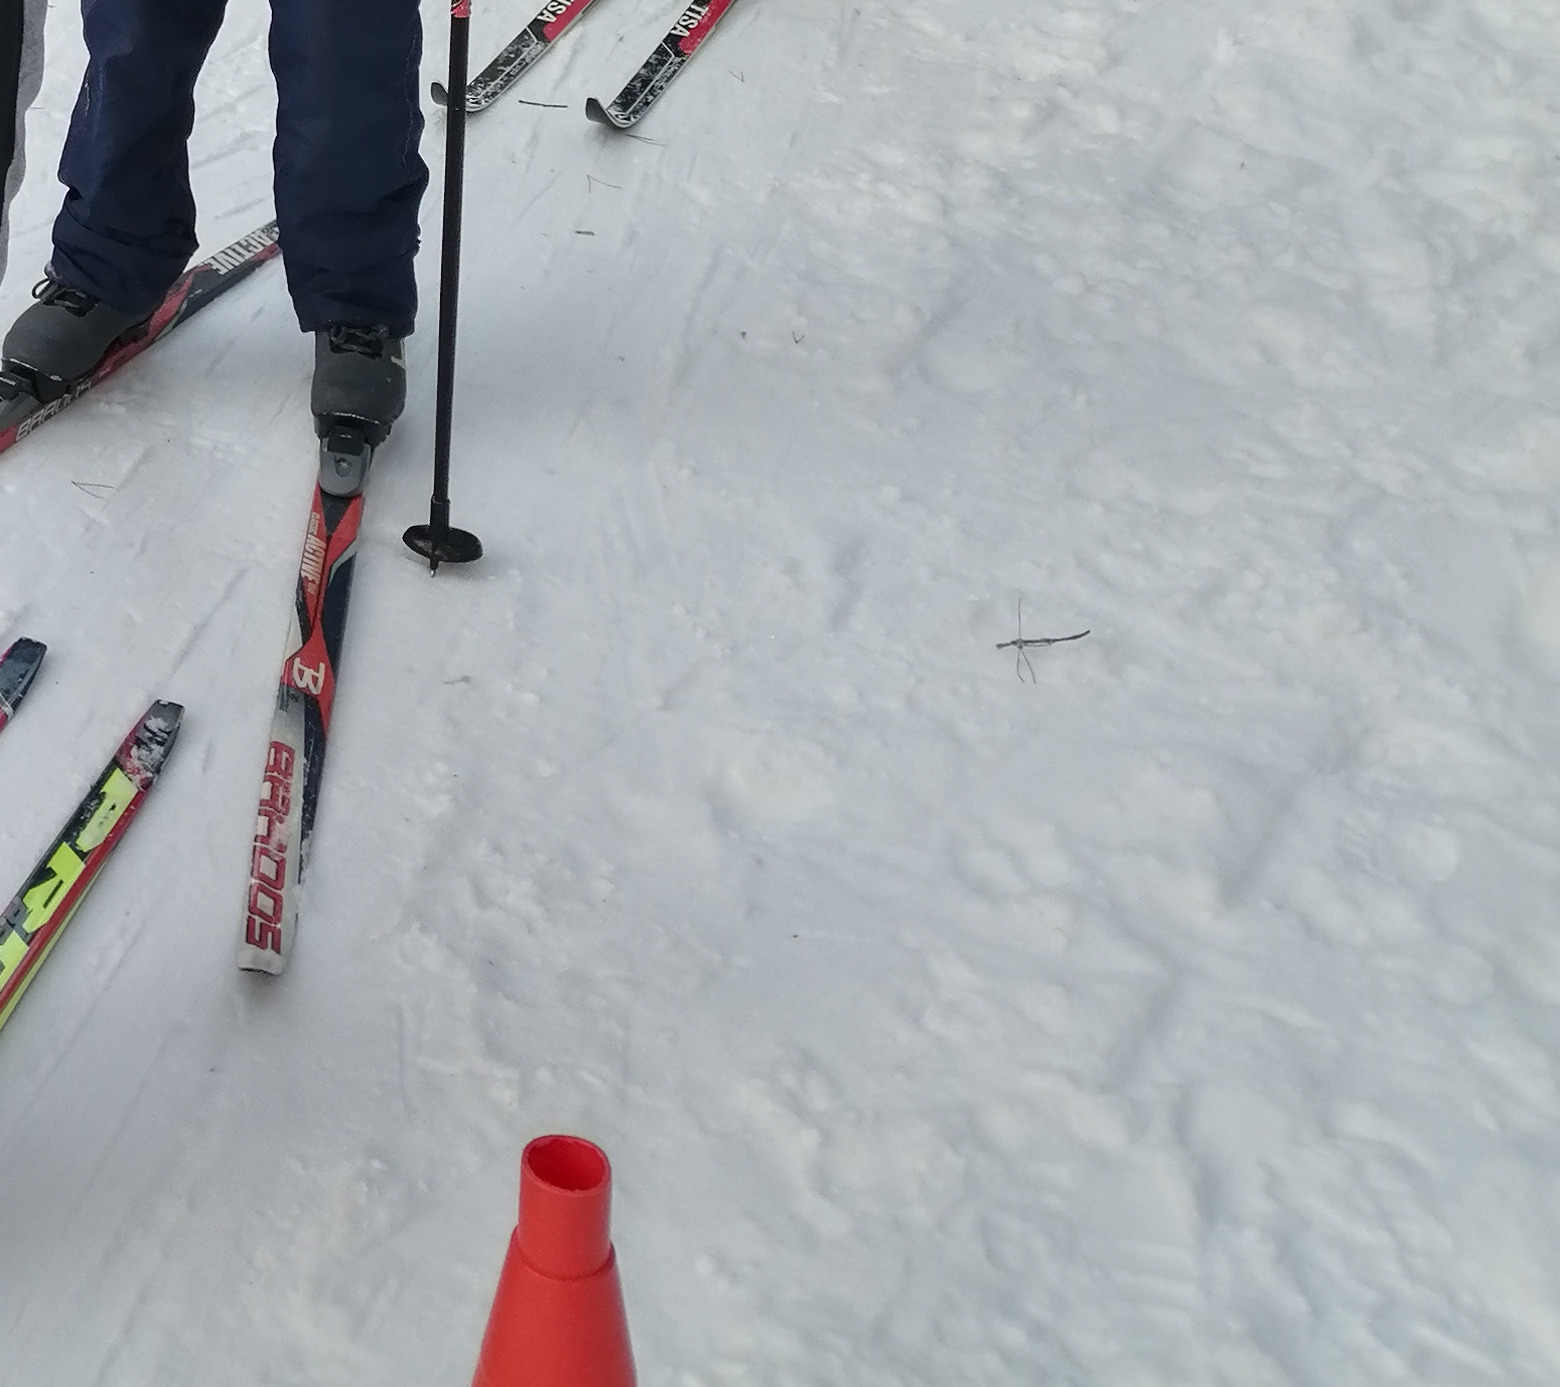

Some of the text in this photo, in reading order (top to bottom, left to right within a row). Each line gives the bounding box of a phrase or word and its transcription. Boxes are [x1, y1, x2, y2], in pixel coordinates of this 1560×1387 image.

[670, 4, 709, 38] TISA
[208, 227, 275, 276] ACTIVE
[300, 533, 326, 584] ACTIVE
[293, 655, 327, 696] B
